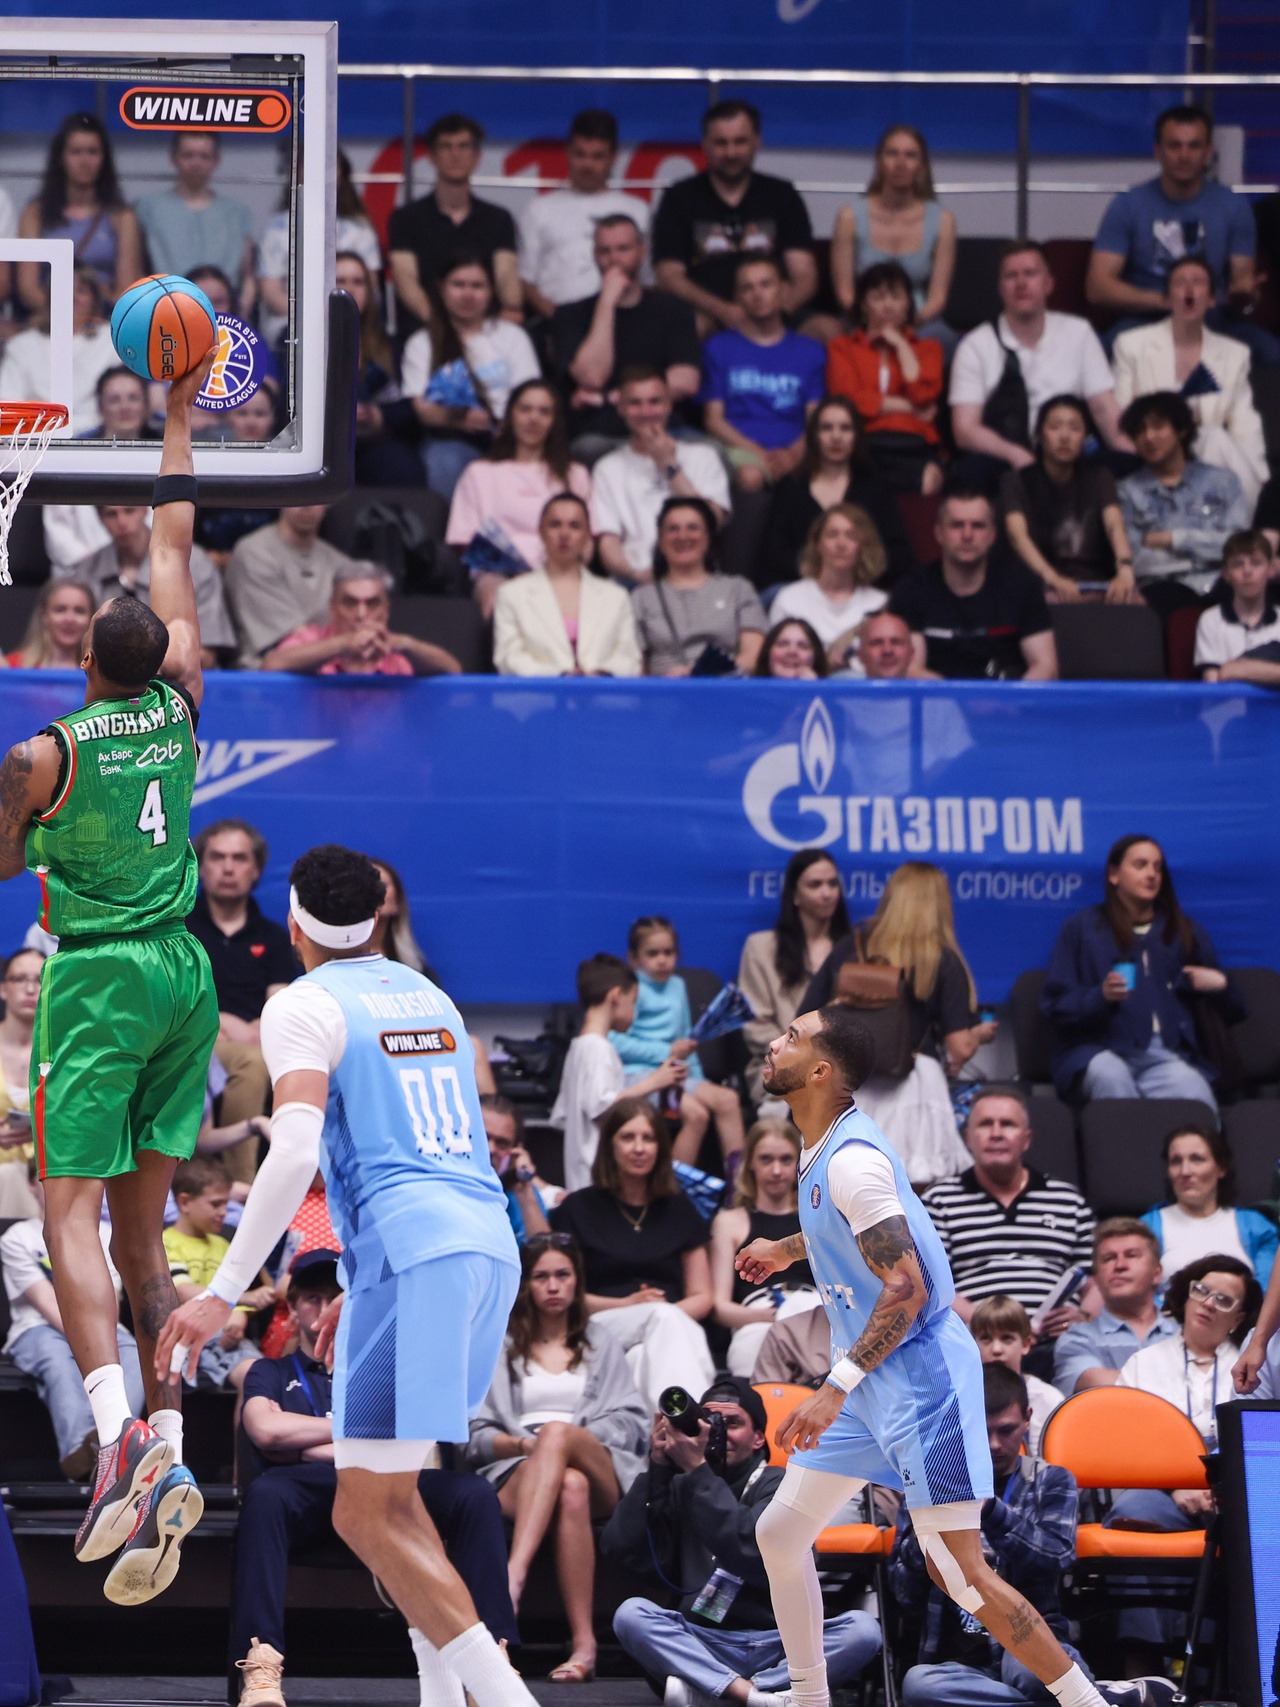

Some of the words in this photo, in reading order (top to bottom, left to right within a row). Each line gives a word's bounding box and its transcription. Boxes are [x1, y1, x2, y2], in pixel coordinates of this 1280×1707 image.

[134, 97, 253, 122] WINLINE
[216, 315, 243, 331] ЛИГА
[241, 327, 259, 346] ВТБ
[159, 325, 178, 380] JÖGEL
[195, 396, 224, 410] NITED
[224, 380, 259, 409] LEAGUE
[71, 707, 167, 742] BINGHAM
[97, 752, 111, 764] Ак
[111, 749, 134, 762] Барс
[99, 765, 123, 776] Банк
[137, 777, 167, 847] 4
[846, 796, 1084, 854] ГАЗПРОМ
[956, 871, 1083, 901] СПОНСОР
[358, 990, 445, 1019] ROBERSON
[384, 1033, 442, 1052] WINLINE
[399, 1066, 473, 1155] 00
